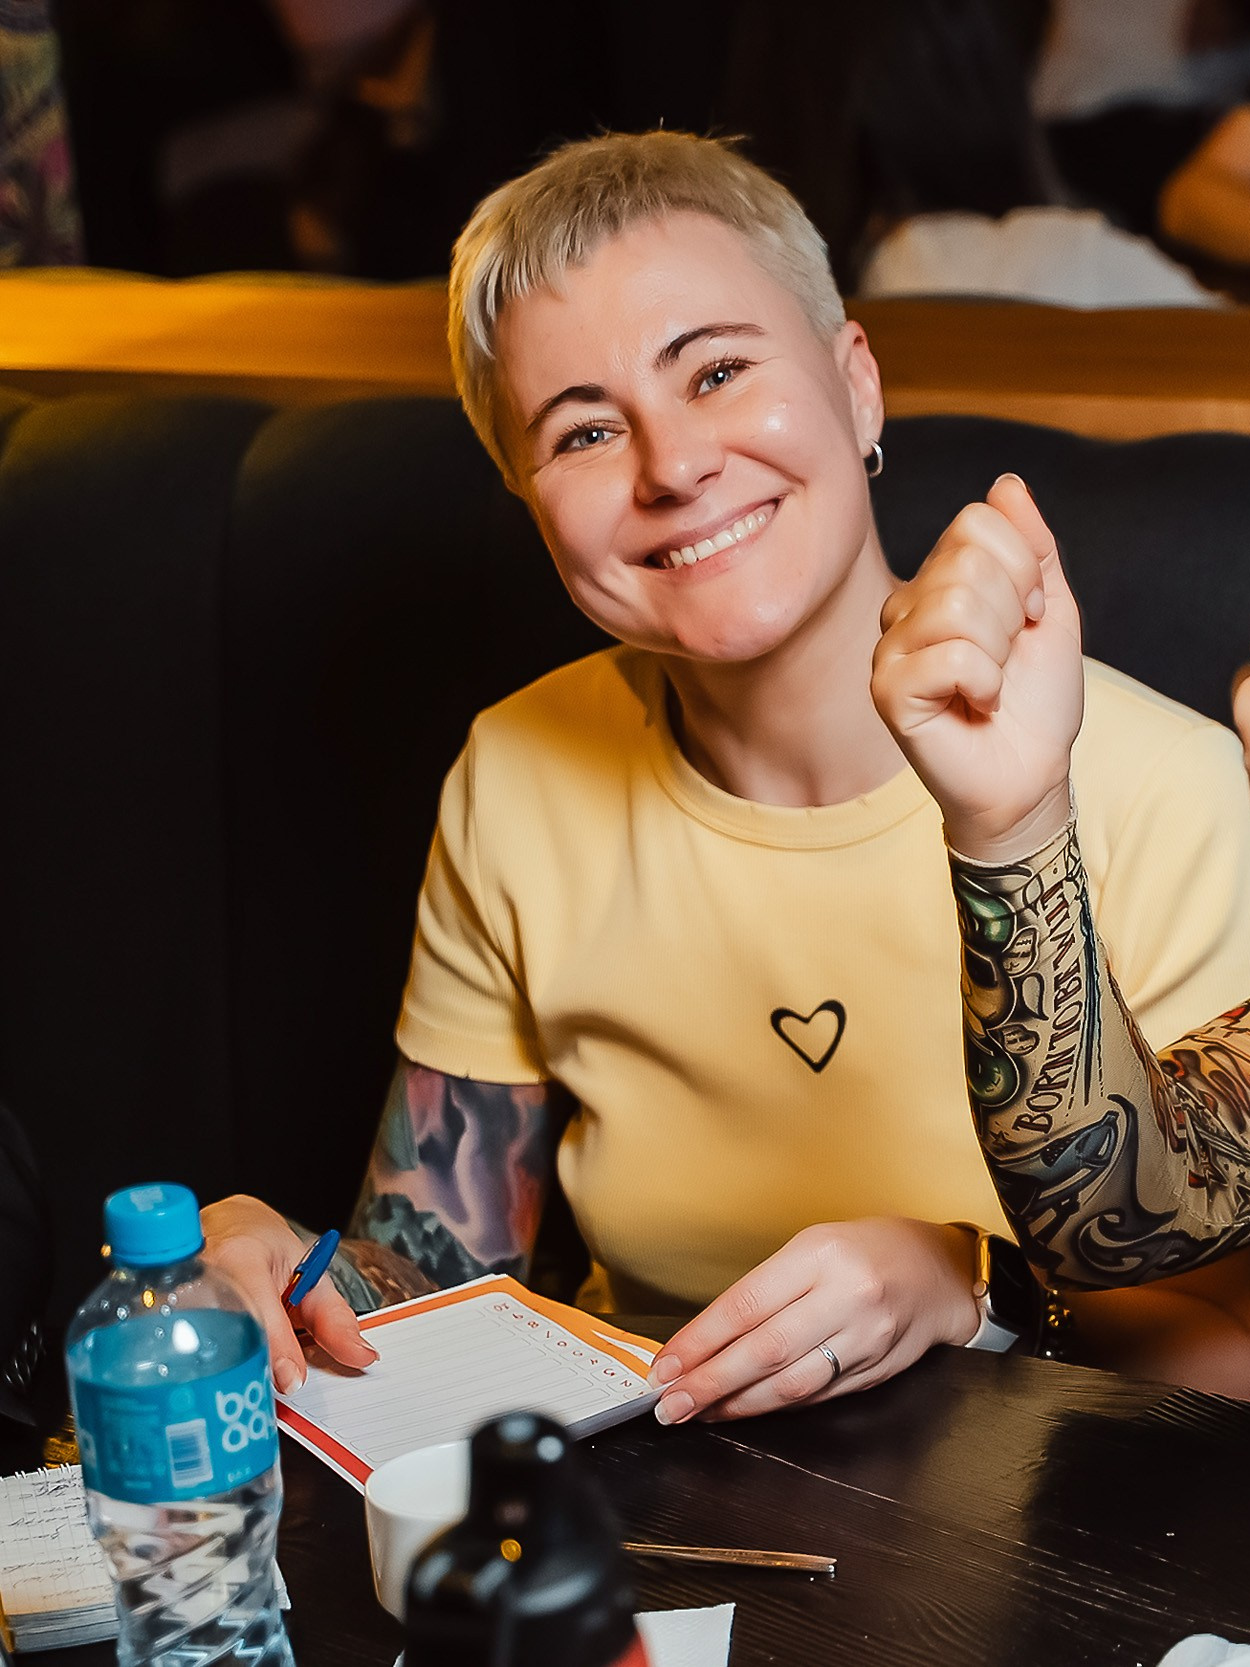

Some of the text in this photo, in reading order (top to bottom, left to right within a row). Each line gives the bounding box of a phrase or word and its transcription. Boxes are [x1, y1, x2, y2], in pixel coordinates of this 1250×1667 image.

[1053, 957, 1083, 1013] BE
[1048, 1000, 1083, 1051] TO
[1012, 1043, 1077, 1134] BORN
